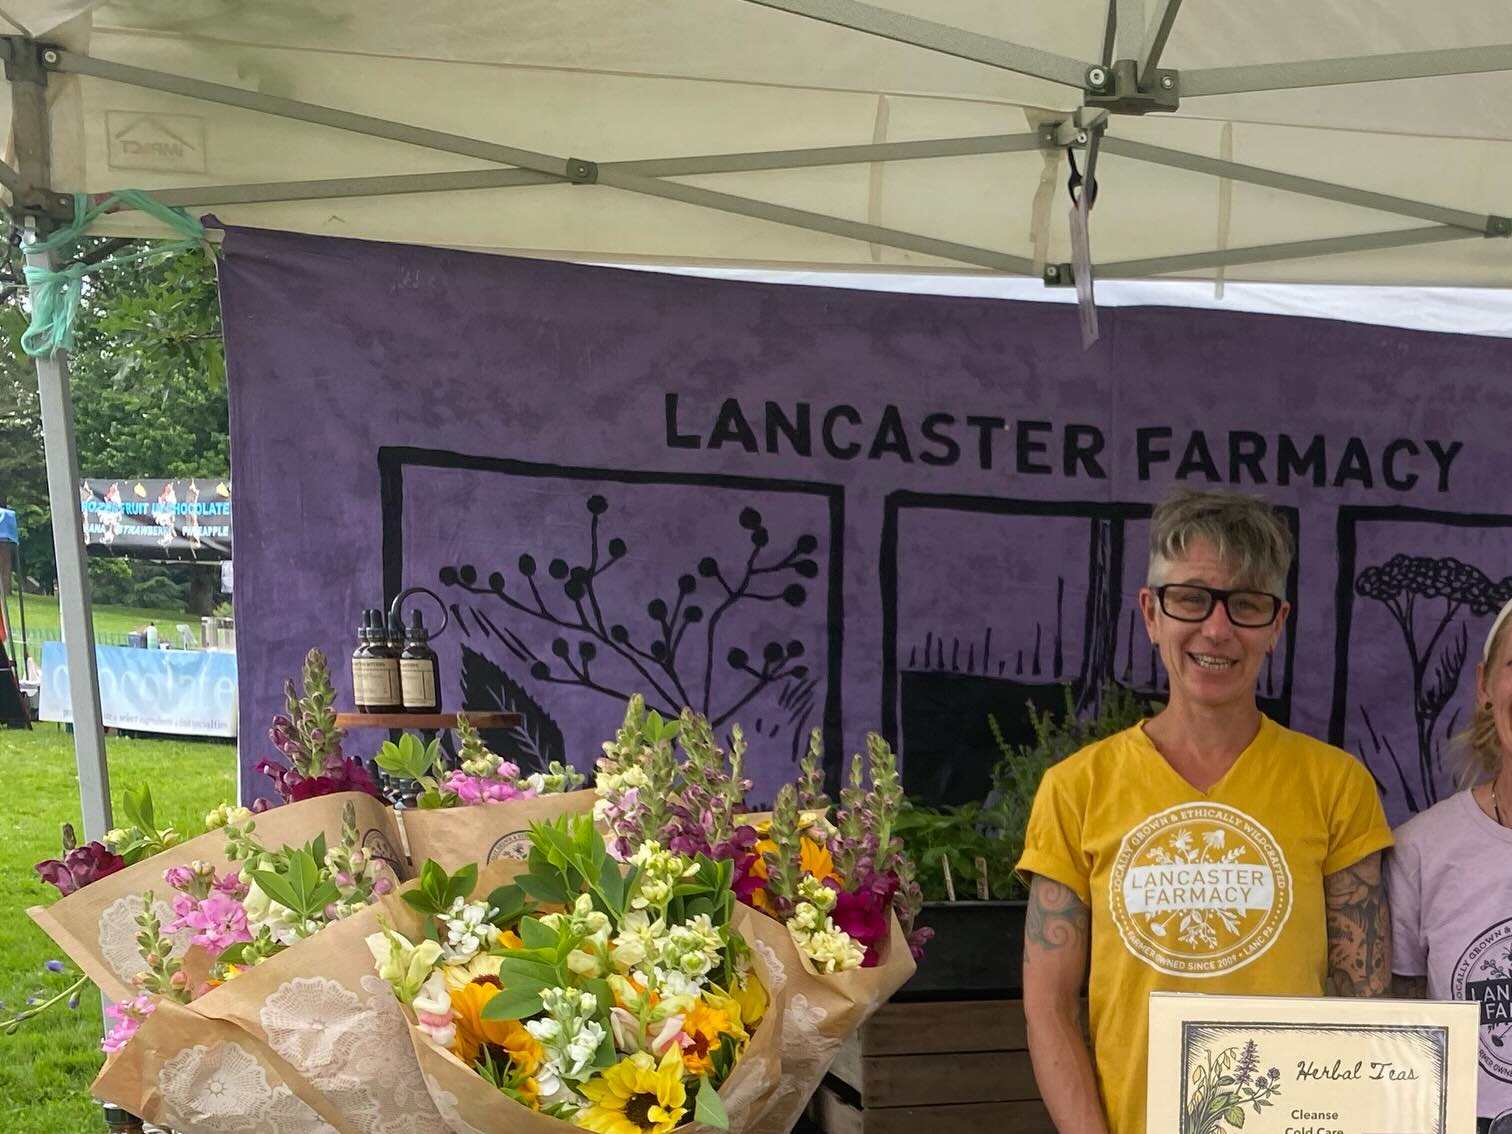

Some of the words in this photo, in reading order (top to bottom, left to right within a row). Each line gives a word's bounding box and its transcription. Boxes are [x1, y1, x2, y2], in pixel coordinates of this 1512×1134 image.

[663, 391, 1107, 480] LANCASTER
[1136, 427, 1465, 492] FARMACY
[1113, 846, 1134, 893] LOCALLY
[1131, 815, 1168, 845] GROWN
[1180, 808, 1242, 827] ETHICALLY
[1131, 869, 1265, 889] LANCASTER
[1144, 886, 1252, 906] FARMACY
[1468, 929, 1502, 960] GROWN
[1295, 1059, 1362, 1082] Herbal
[1369, 1061, 1420, 1081] Teas
[1291, 1109, 1339, 1121] Cleanse
